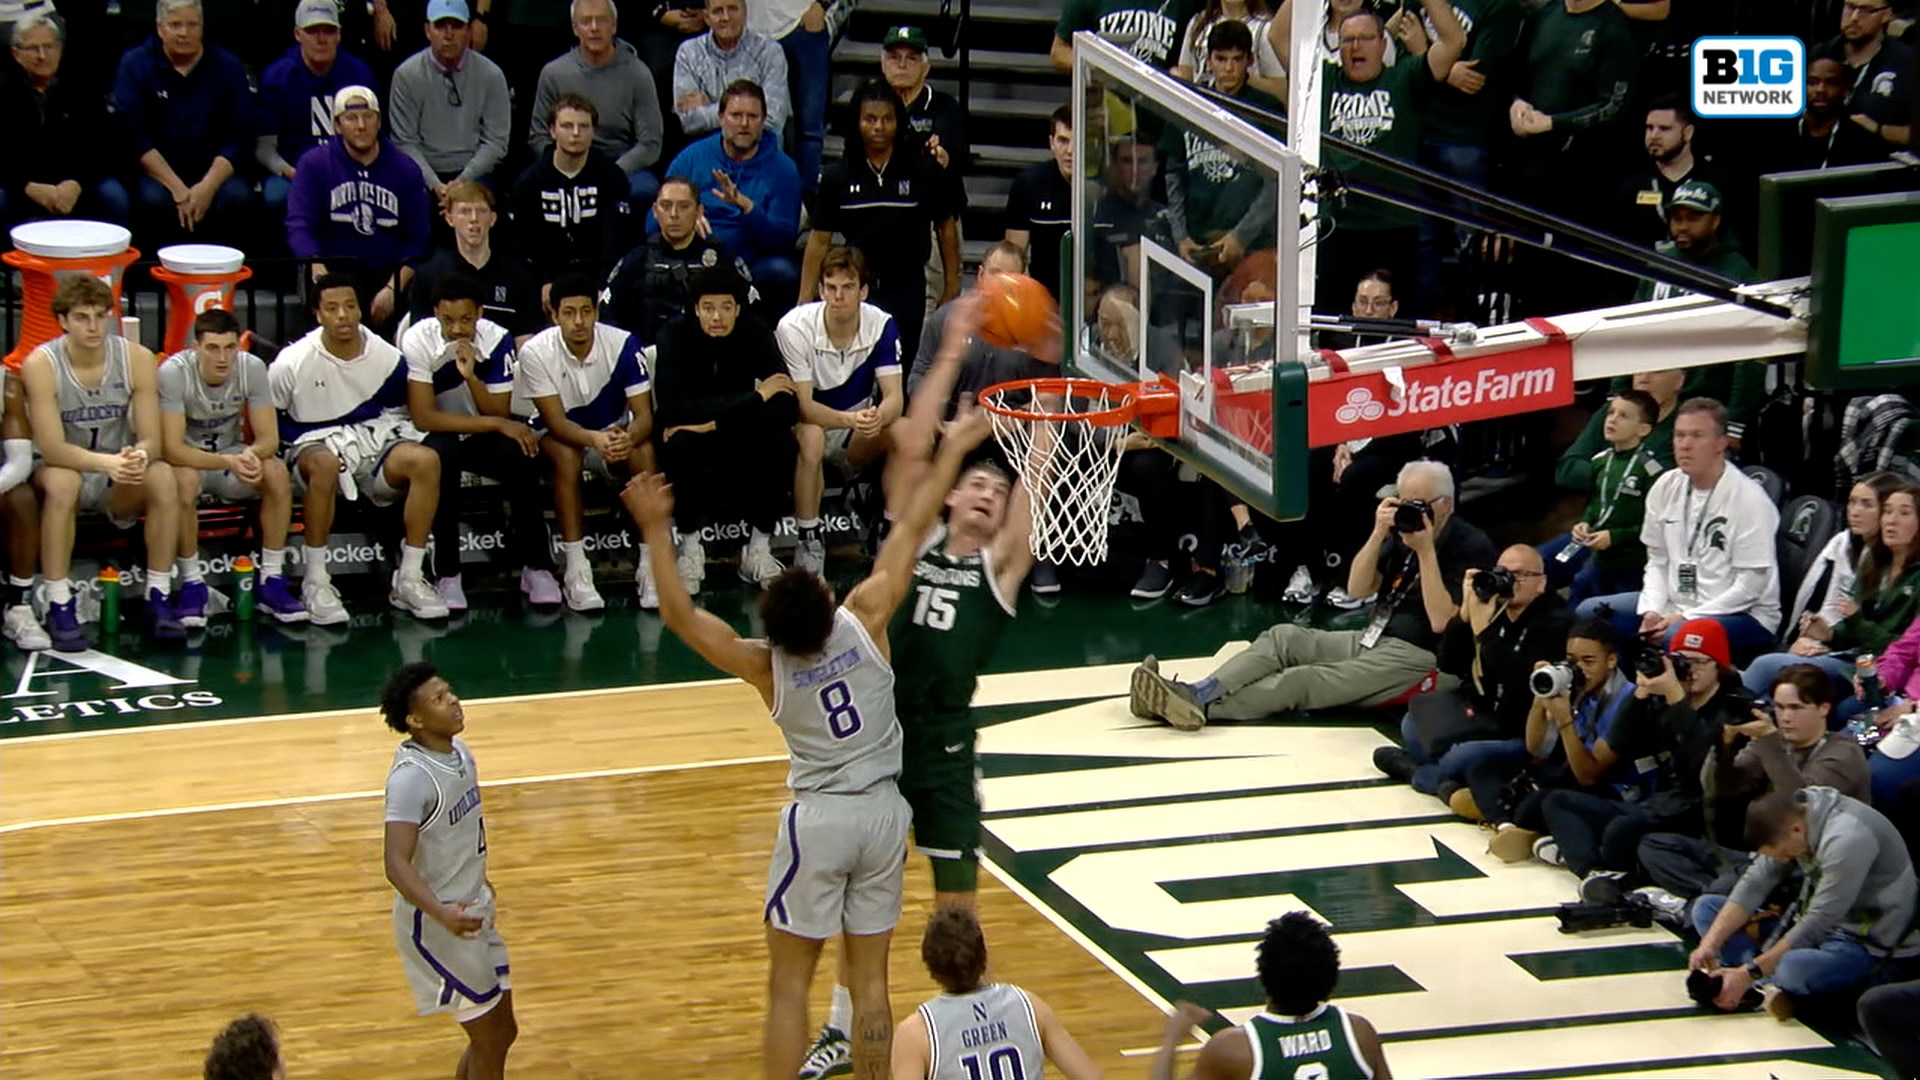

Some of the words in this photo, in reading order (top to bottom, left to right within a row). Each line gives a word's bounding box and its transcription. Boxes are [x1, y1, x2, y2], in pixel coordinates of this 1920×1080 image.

[458, 530, 505, 551] cket
[553, 530, 632, 552] Rcket
[303, 542, 386, 565] ocket
[240, 577, 253, 591] G
[912, 585, 960, 631] 15
[818, 680, 863, 740] 8
[972, 1002, 988, 1022] N
[961, 1021, 1008, 1048] GREEN
[1278, 1028, 1332, 1058] WARD
